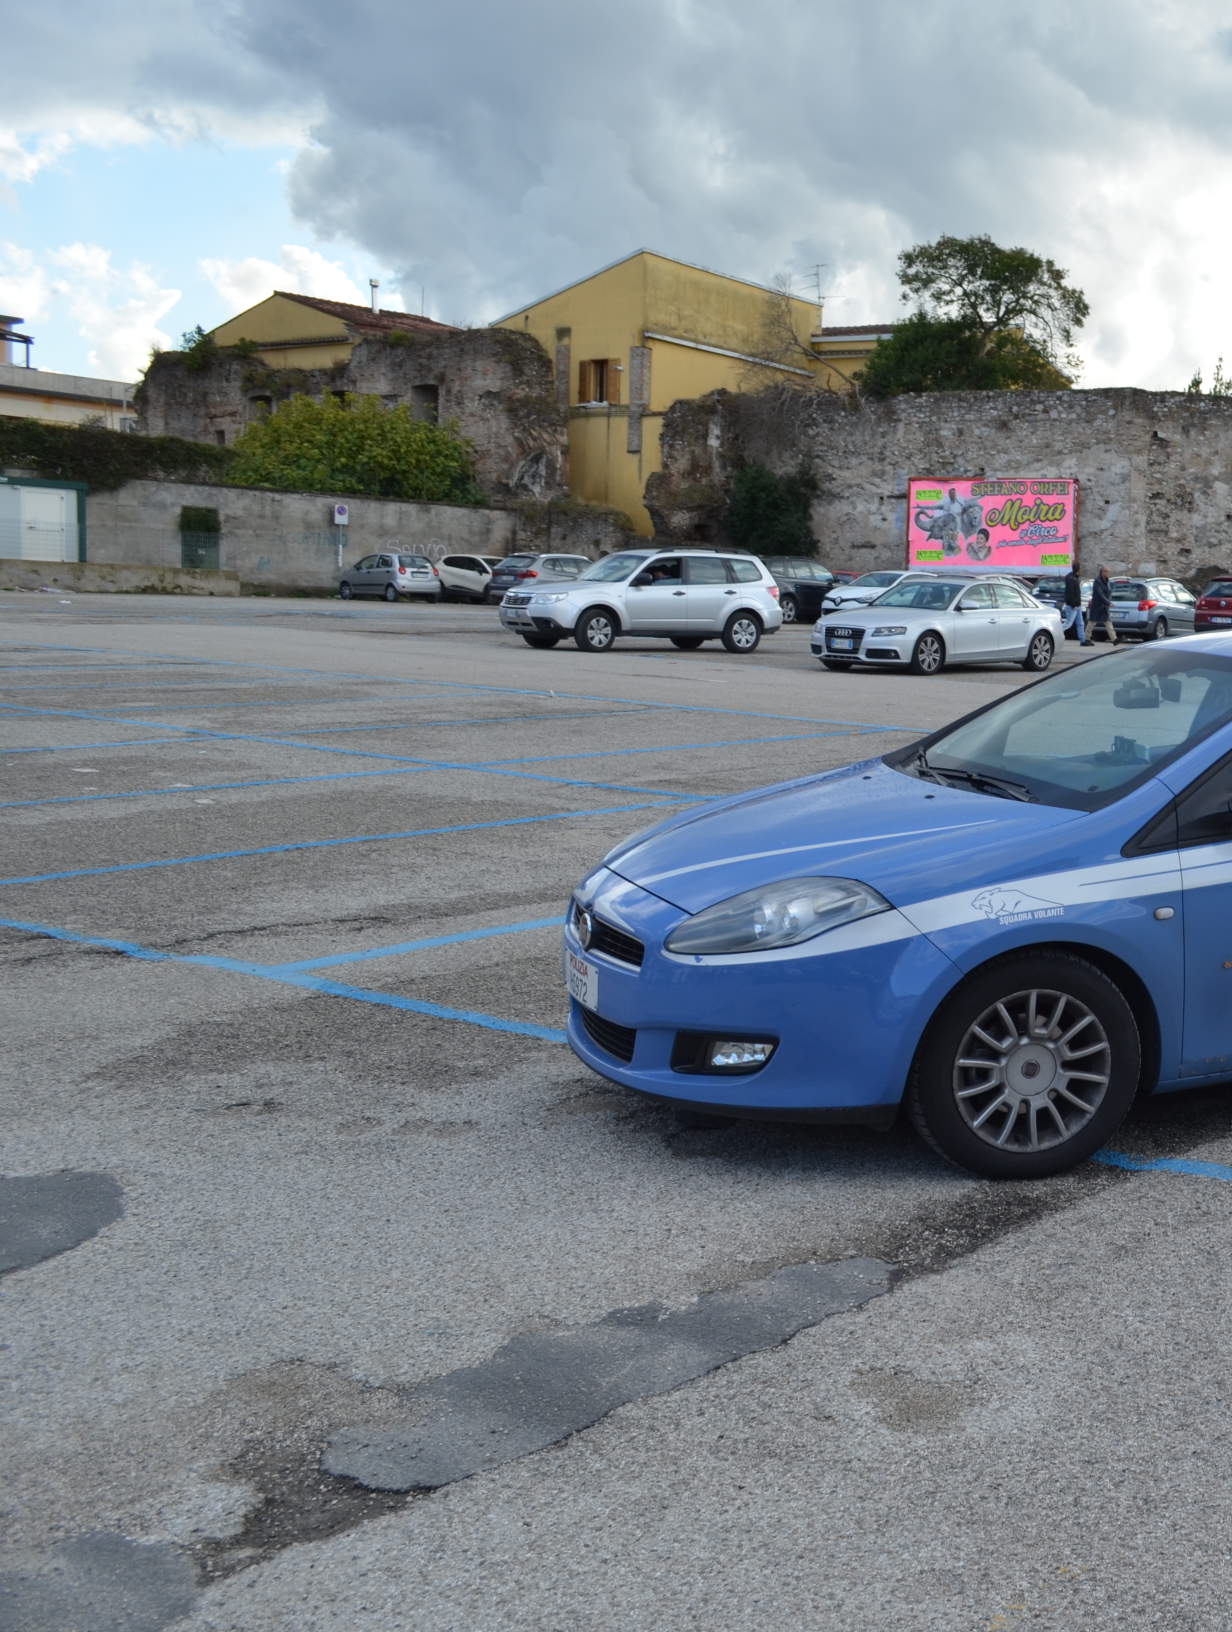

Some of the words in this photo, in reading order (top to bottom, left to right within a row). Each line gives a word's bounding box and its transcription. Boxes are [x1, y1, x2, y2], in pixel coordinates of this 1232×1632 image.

[972, 481, 1027, 496] STEFANO
[1029, 481, 1069, 495] ORFEI
[986, 499, 1065, 530] Moira
[1000, 913, 1032, 925] SQUADRA
[1034, 908, 1064, 919] VOLANTE
[569, 954, 587, 976] POLIZIA
